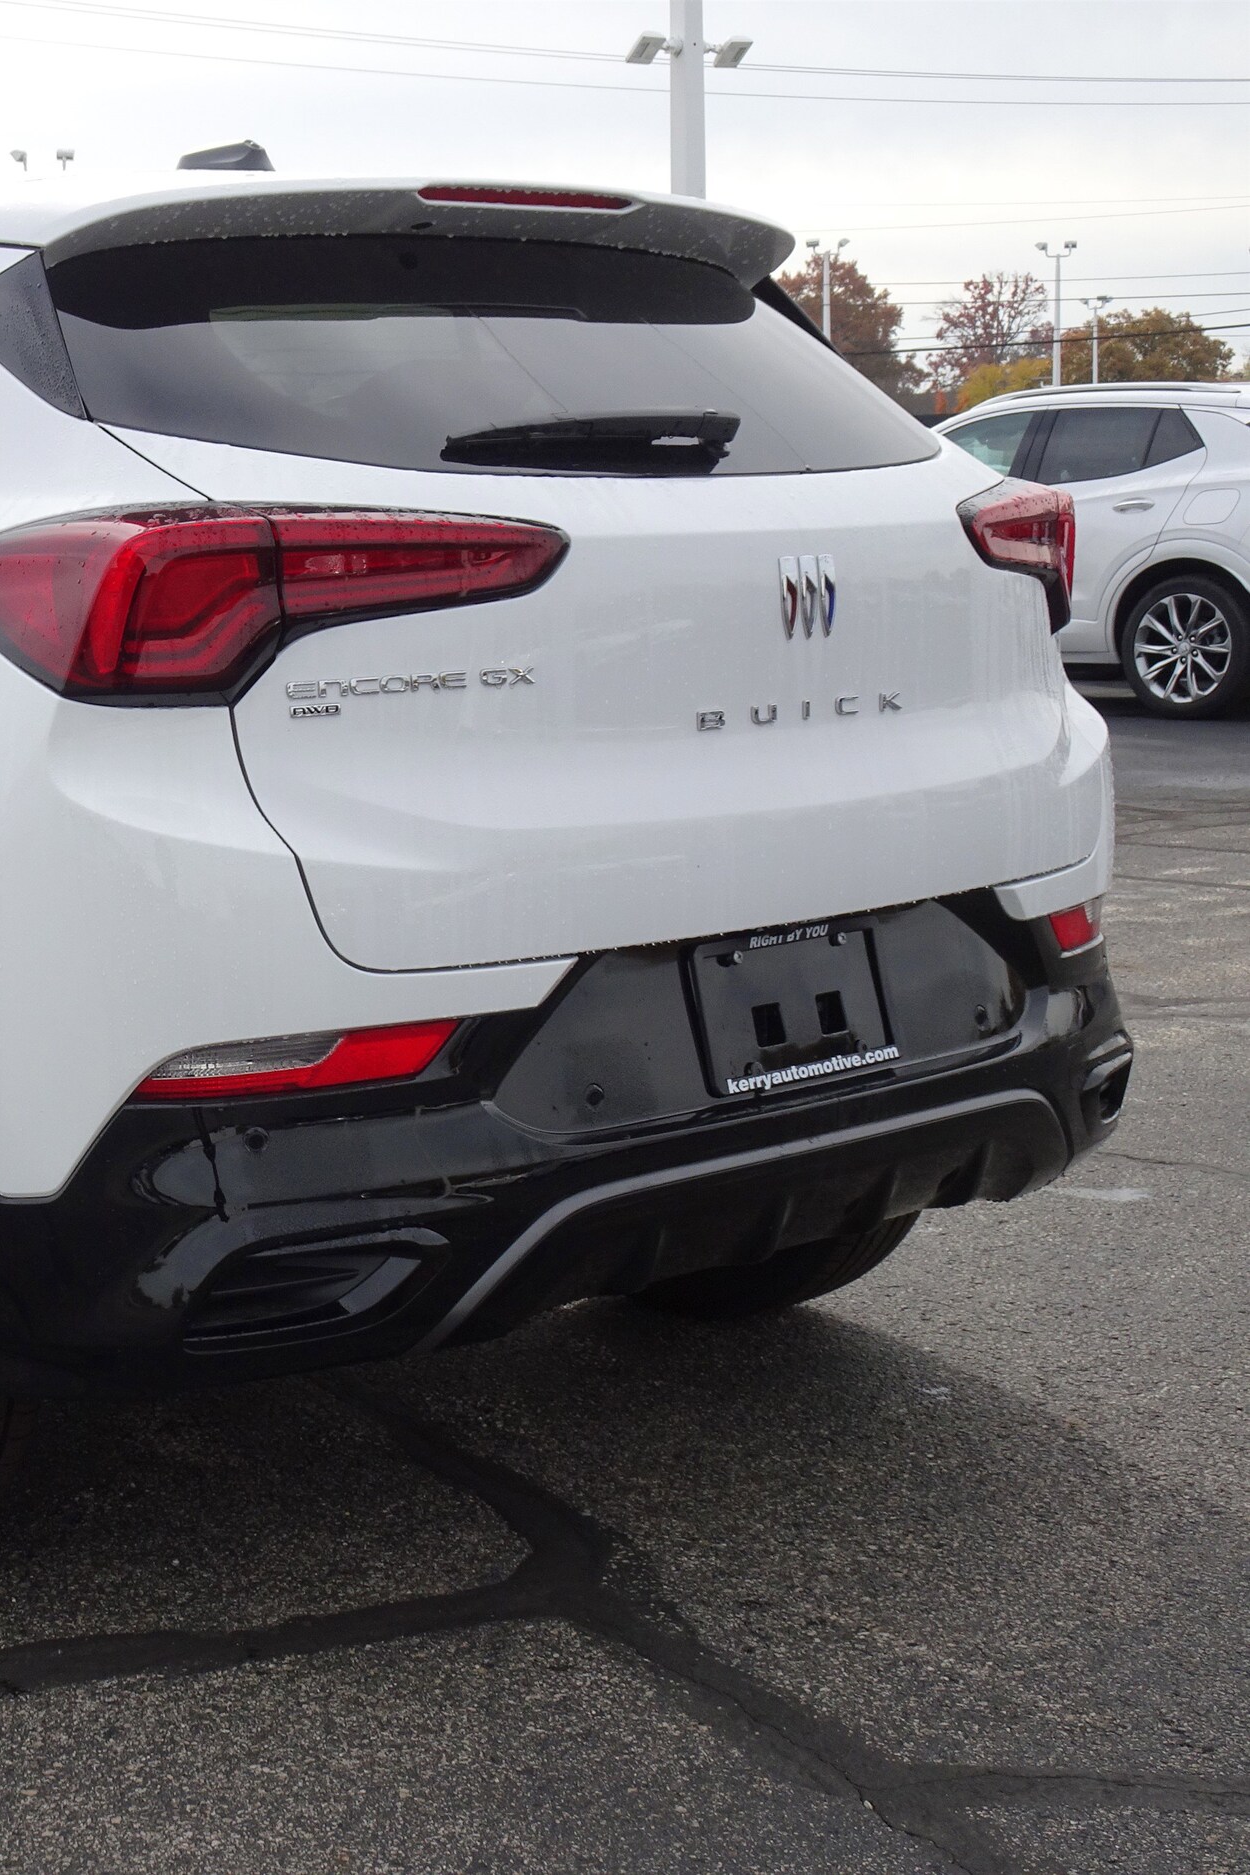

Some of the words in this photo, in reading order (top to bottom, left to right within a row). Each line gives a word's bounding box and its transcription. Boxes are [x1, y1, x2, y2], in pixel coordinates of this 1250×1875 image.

[285, 669, 468, 700] ENCORE
[478, 666, 536, 687] GX
[291, 703, 341, 718] AWD
[696, 691, 902, 732] BUICK
[805, 924, 829, 939] YOU
[726, 1046, 900, 1094] kerryautomotive.com
